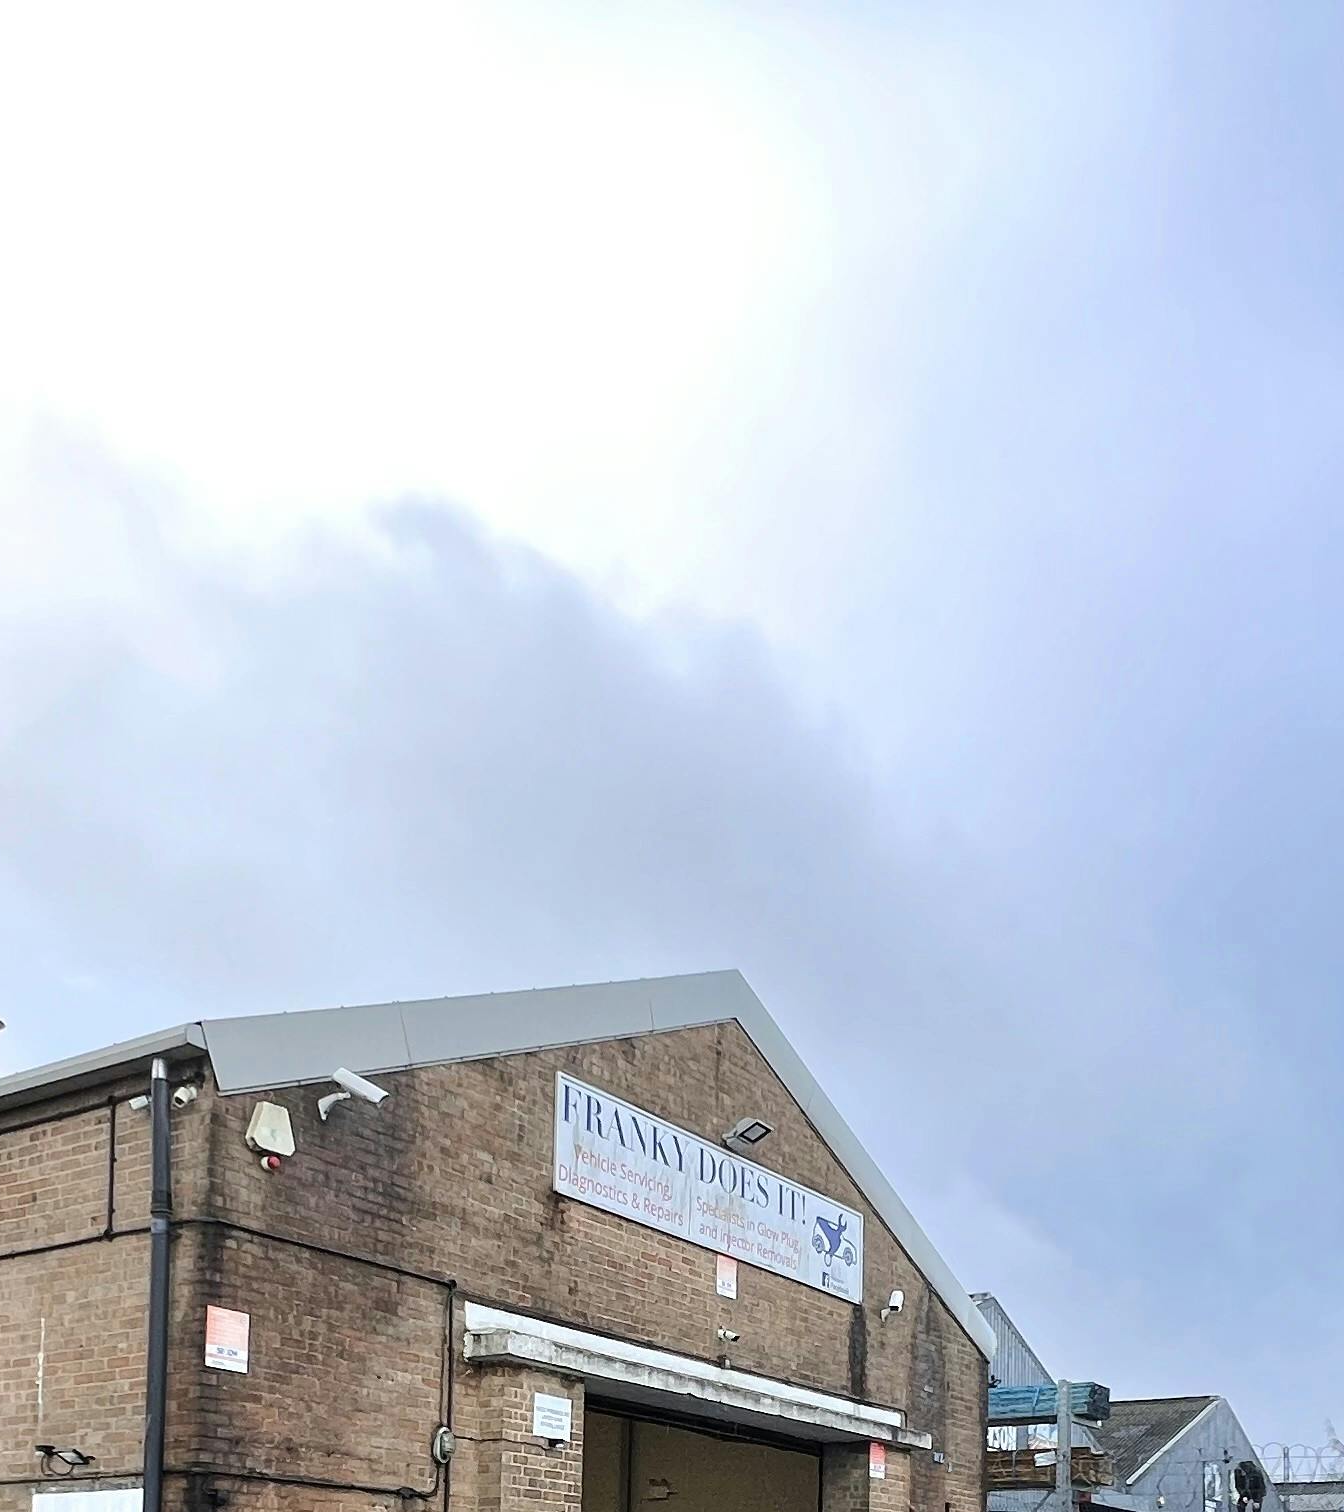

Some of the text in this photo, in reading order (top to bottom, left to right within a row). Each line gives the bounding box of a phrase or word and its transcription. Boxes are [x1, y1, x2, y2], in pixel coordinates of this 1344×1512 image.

[563, 1085, 806, 1225] FRANKY DOES IT!
[574, 1144, 617, 1177] Vehicle
[558, 1164, 684, 1227] Diagnostics & Repairs
[699, 1223, 717, 1241] and
[757, 1241, 797, 1271] Removals
[756, 1222, 779, 1242] Glow
